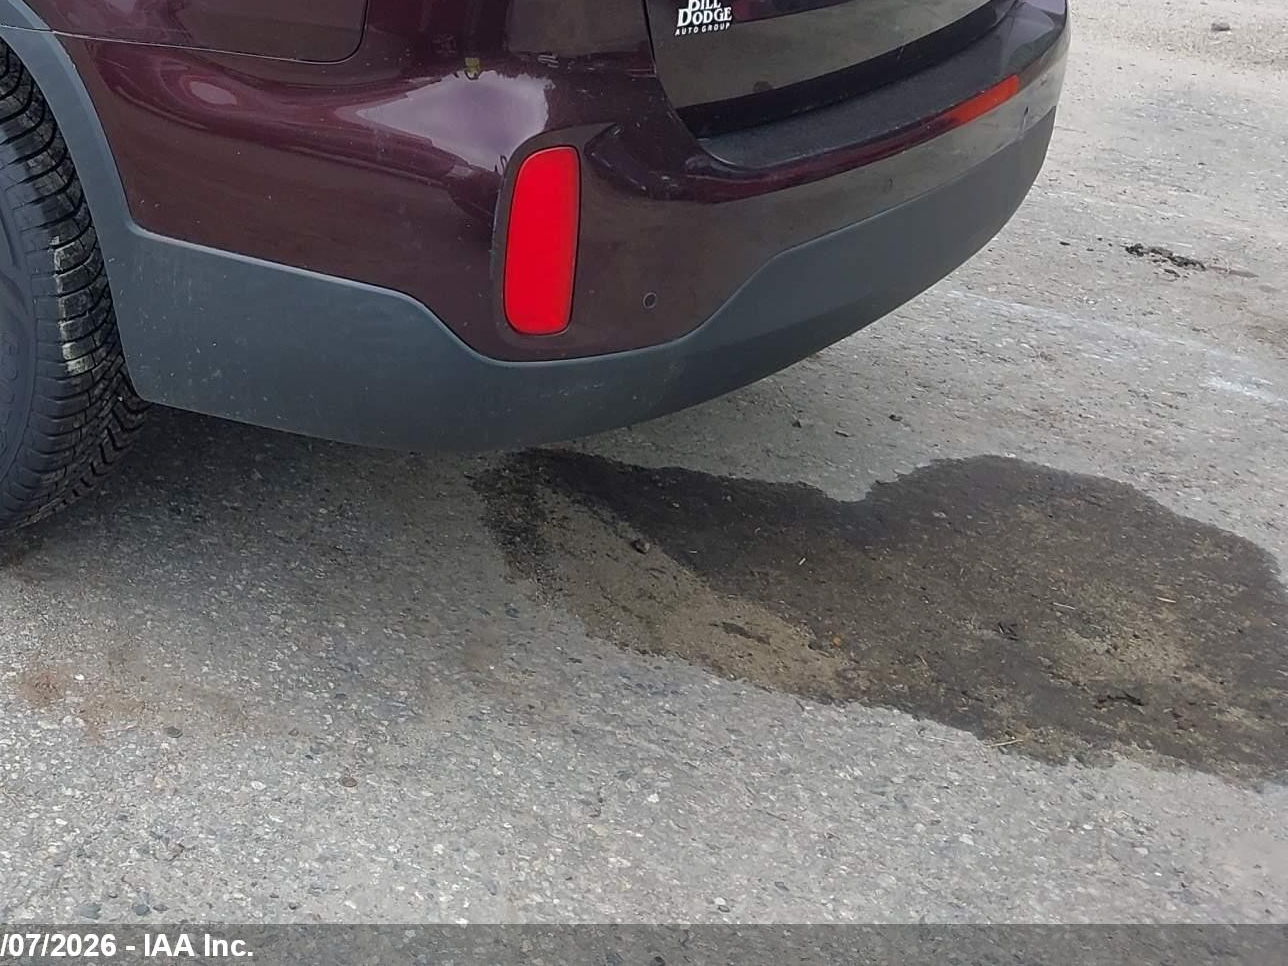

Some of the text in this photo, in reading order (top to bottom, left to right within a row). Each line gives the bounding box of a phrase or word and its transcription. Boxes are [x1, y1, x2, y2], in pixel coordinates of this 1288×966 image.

[676, 7, 733, 27] DODGE
[674, 22, 731, 36] AUTO GROUP
